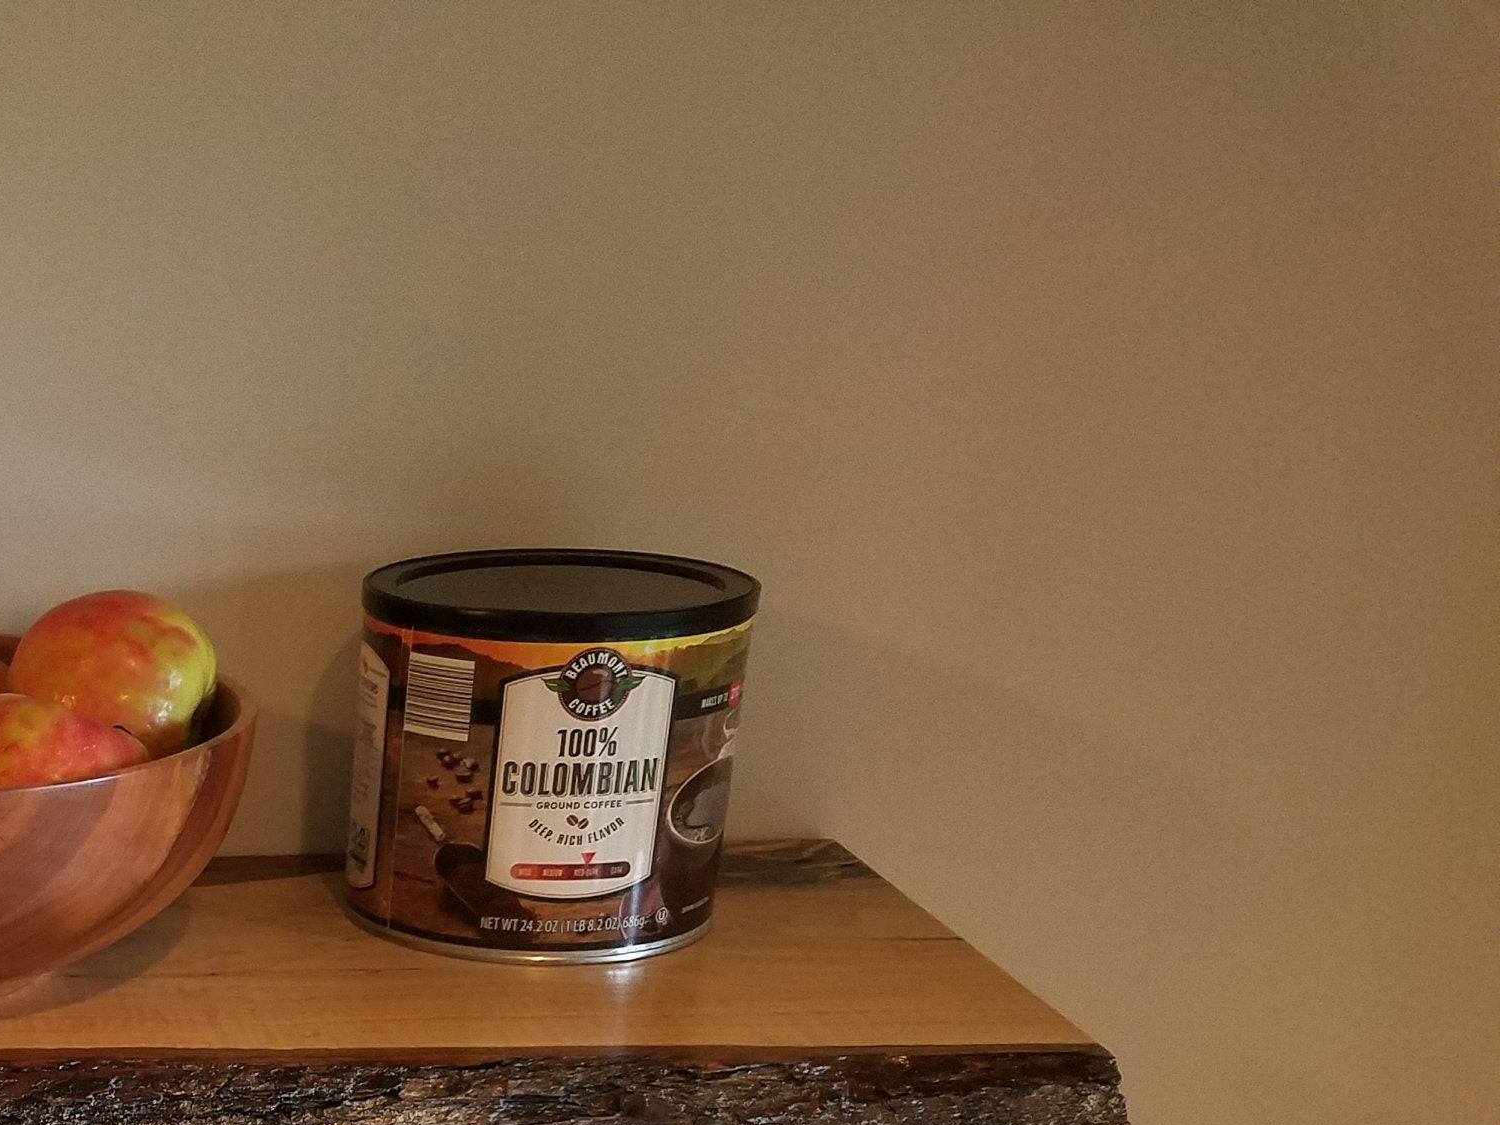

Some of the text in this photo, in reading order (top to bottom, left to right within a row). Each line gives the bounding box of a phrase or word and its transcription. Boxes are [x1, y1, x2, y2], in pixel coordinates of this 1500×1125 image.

[565, 652, 627, 680] BEAUMONT
[568, 698, 615, 716] COFFEE
[557, 727, 618, 757] 100%
[502, 758, 660, 797] COLOMBIAN
[536, 800, 622, 810] GROUND COFFEE
[556, 833, 583, 846] RICH
[588, 817, 625, 844] FLAVOR
[480, 916, 500, 929] NET
[502, 918, 519, 931] WT
[520, 919, 542, 932] 24.2
[544, 920, 558, 933] OZ
[573, 919, 586, 932] LB
[588, 918, 603, 932] 8.2
[604, 916, 622, 931] OZ)
